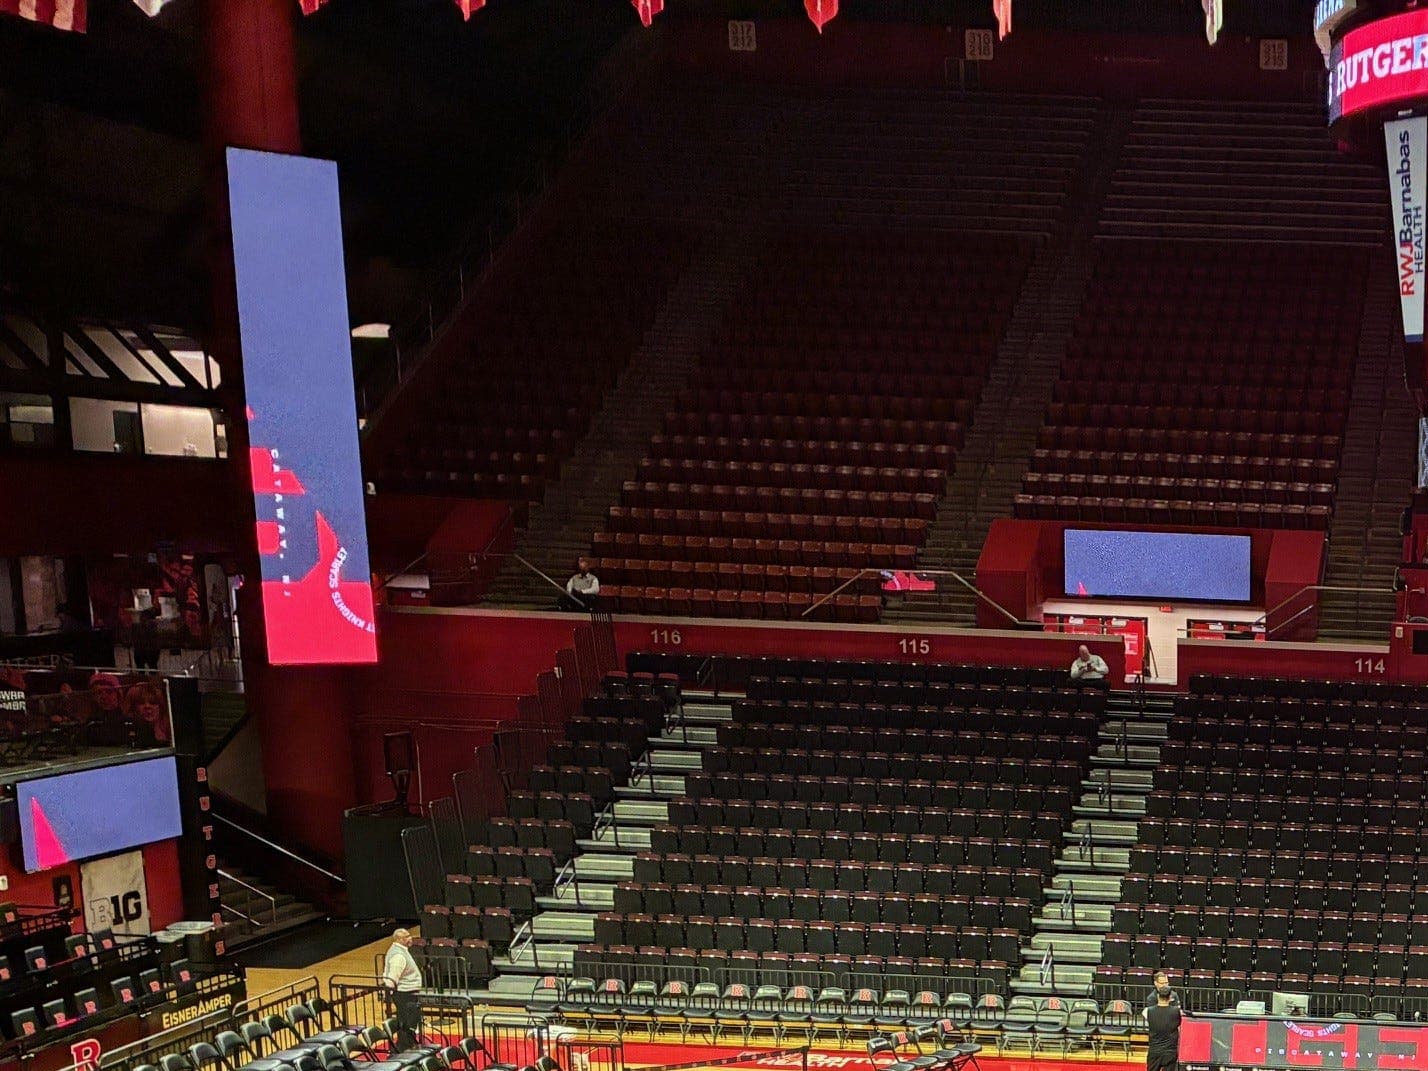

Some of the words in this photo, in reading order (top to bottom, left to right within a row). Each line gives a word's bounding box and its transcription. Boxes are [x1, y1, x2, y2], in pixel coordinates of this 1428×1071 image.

[1396, 130, 1415, 296] RWJBarnabas
[1413, 206, 1424, 273] HEALTH
[650, 629, 682, 645] 116
[899, 639, 930, 654] 115
[1354, 658, 1385, 674] 114
